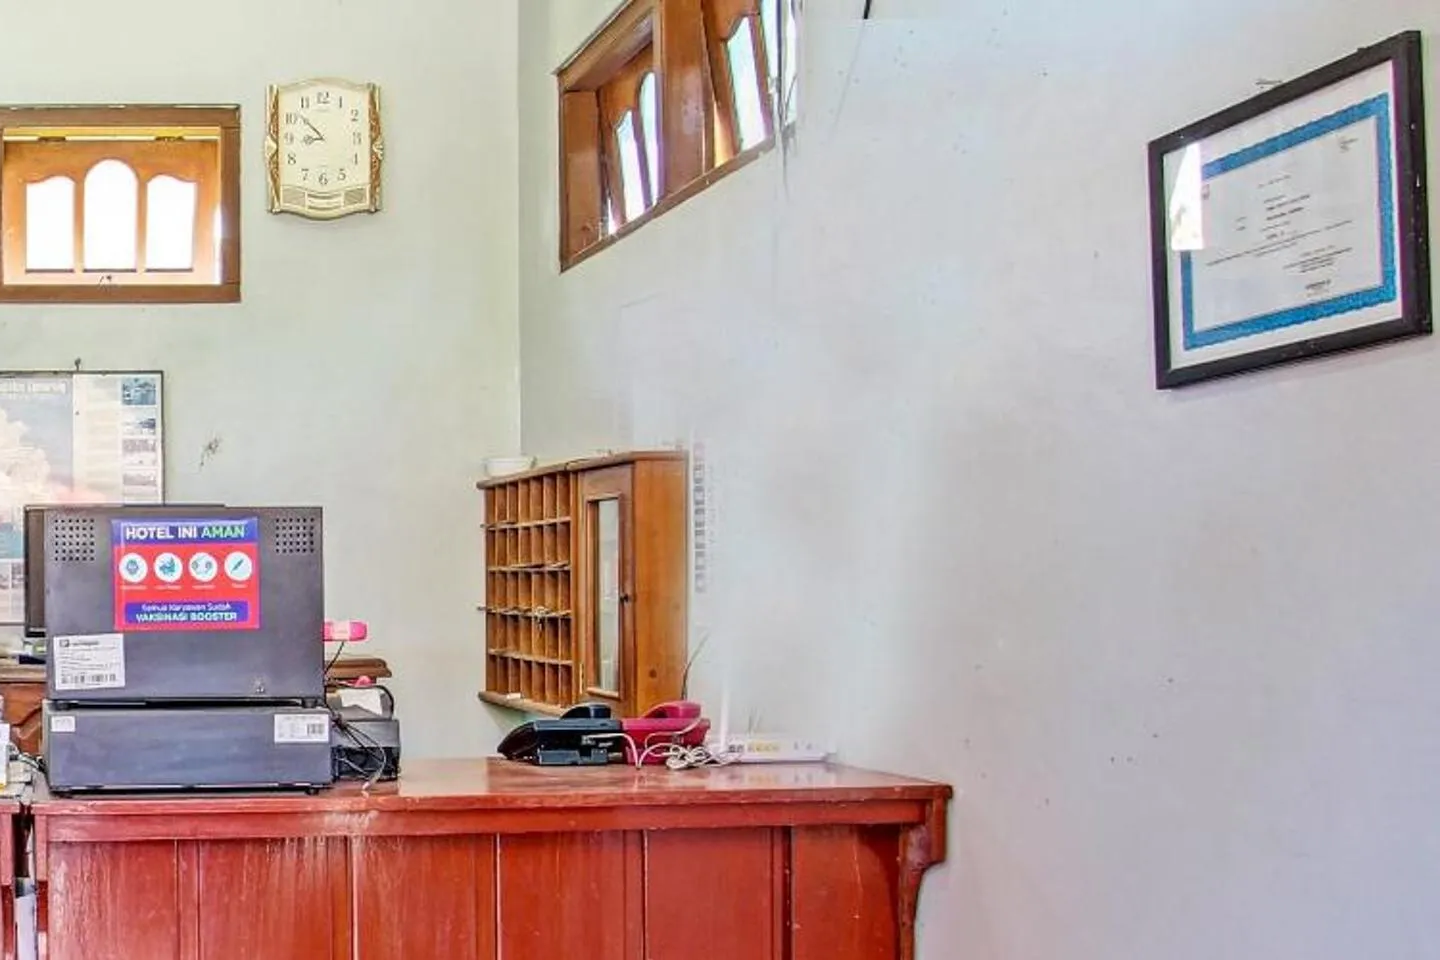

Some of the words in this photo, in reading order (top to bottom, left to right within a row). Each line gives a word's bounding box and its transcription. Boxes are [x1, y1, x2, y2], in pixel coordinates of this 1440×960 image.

[285, 113, 297, 125] 10
[350, 109, 359, 122] 2
[287, 153, 297, 165] 8
[301, 168, 309, 181] 7
[318, 172, 329, 185] 6
[338, 168, 346, 181] 5
[126, 526, 174, 540] HOTEL
[178, 526, 197, 538] INI
[201, 525, 245, 538] AMAN
[189, 611, 237, 622] BOOSTER
